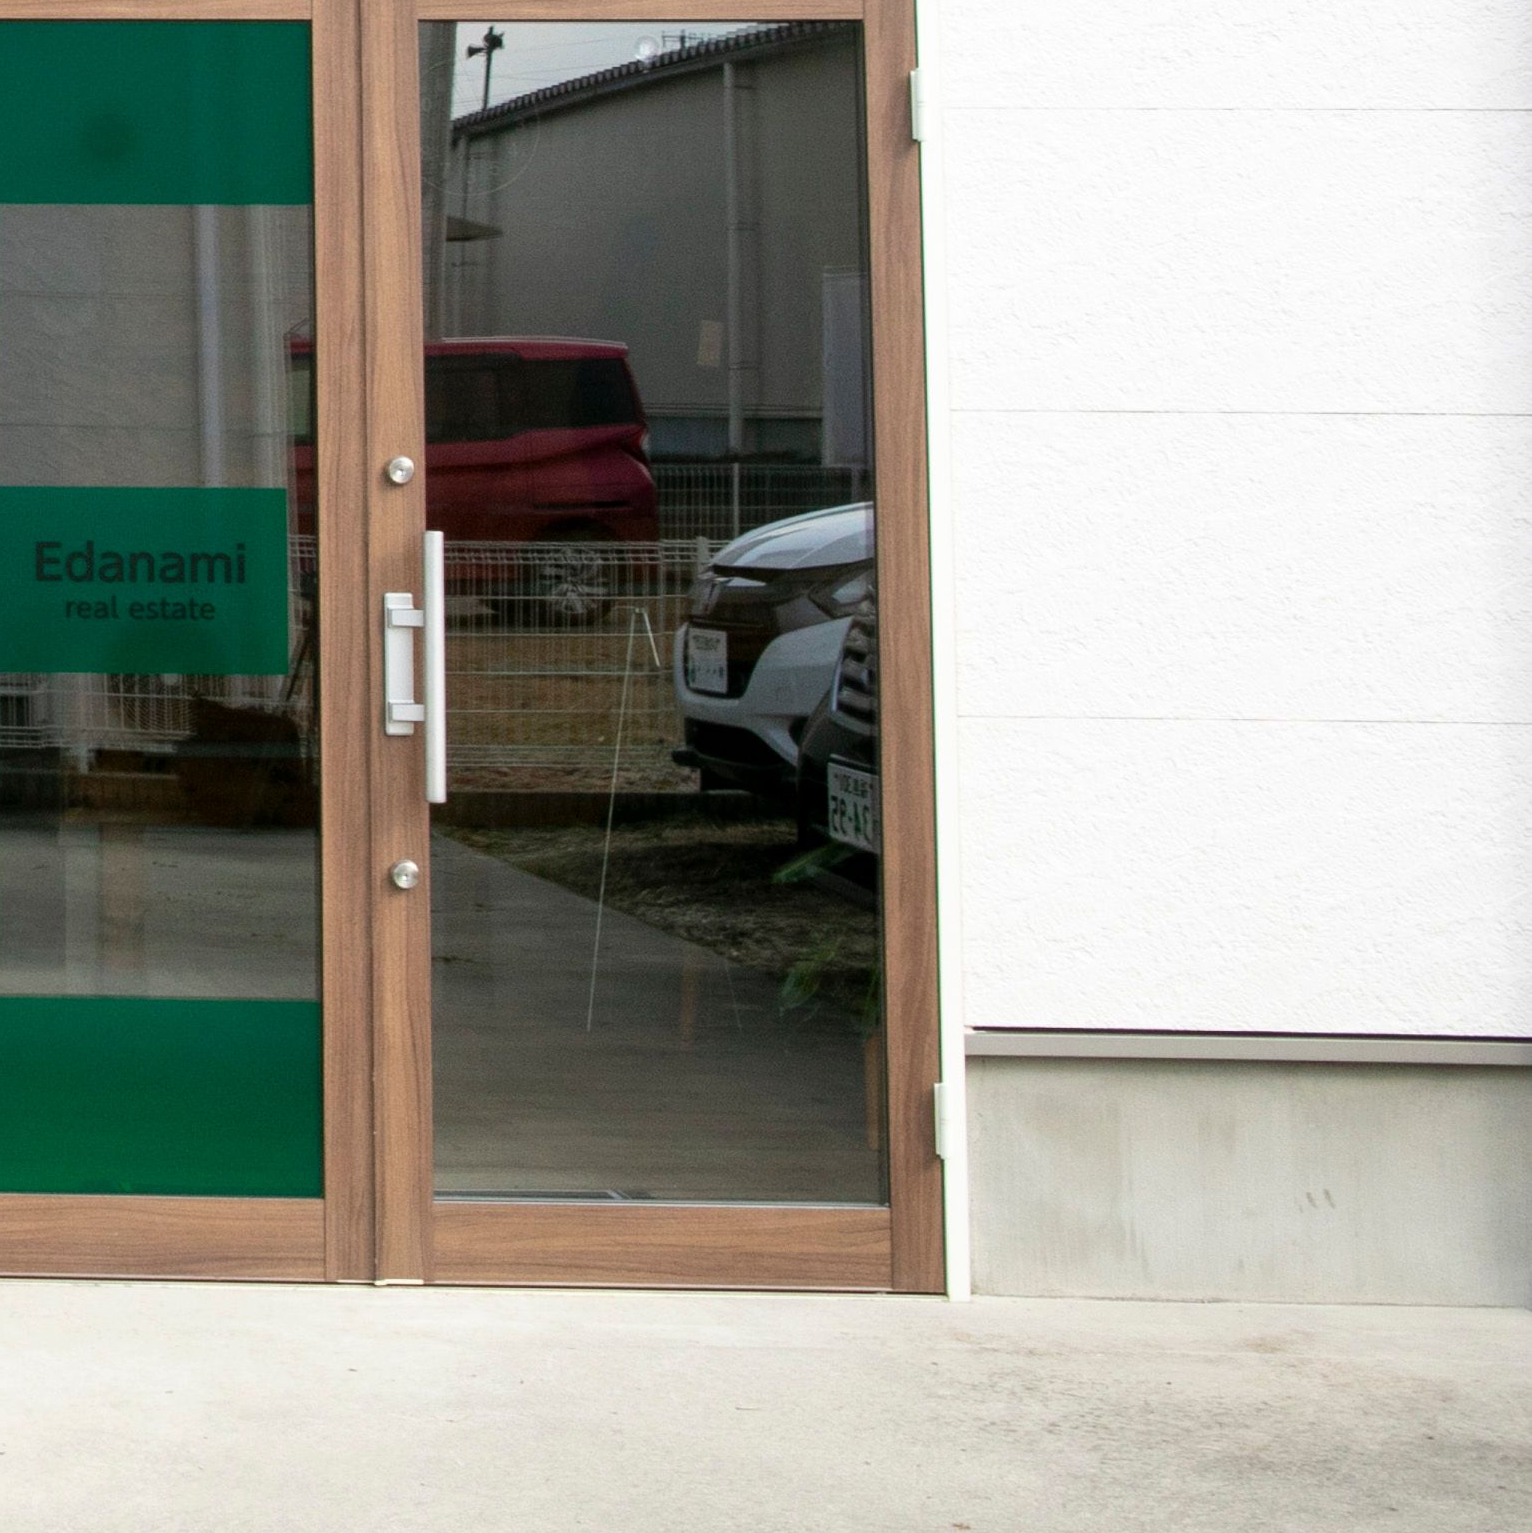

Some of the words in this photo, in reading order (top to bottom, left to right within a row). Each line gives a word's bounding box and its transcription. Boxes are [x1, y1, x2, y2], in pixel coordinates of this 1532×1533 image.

[35, 539, 247, 584] Edanami
[64, 594, 120, 619] real
[128, 596, 216, 620] estate
